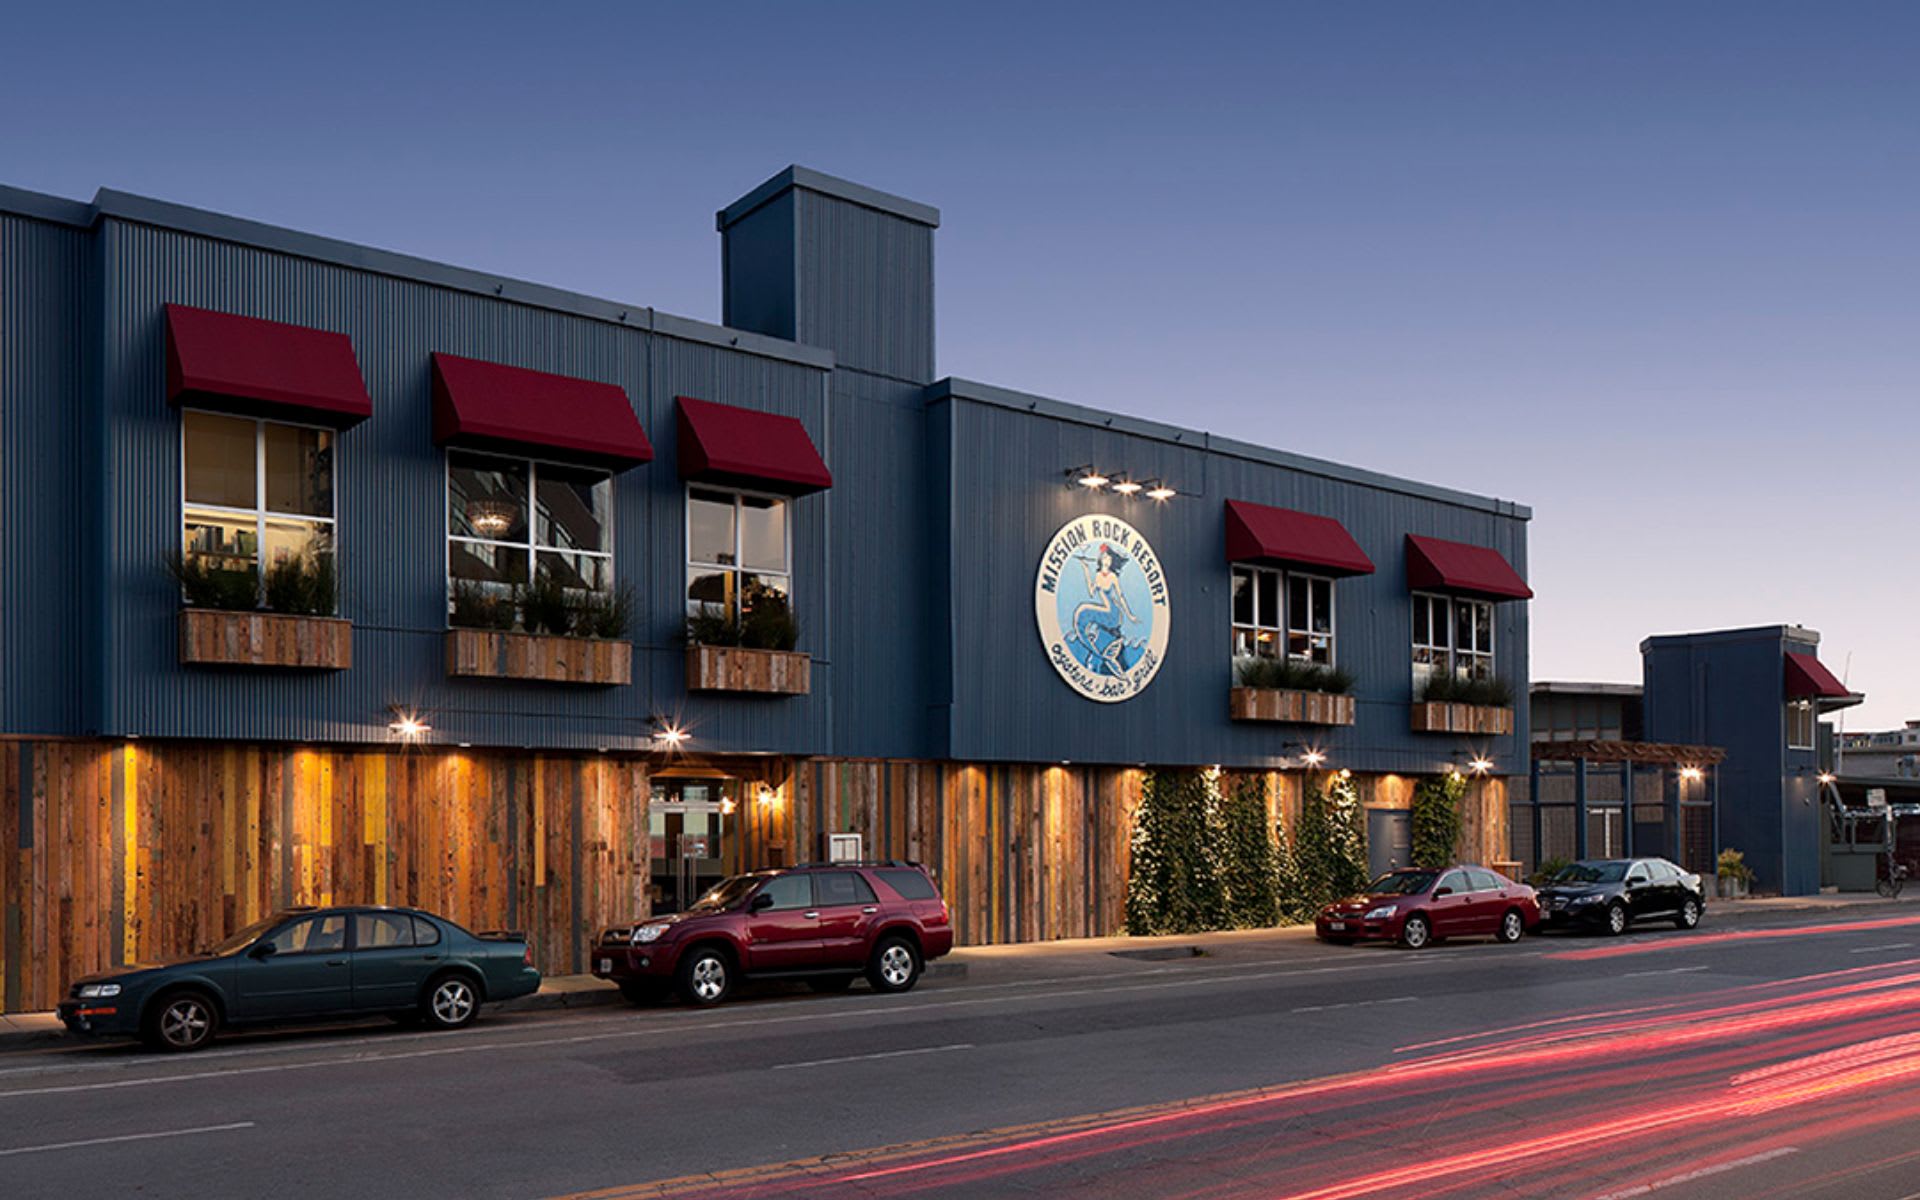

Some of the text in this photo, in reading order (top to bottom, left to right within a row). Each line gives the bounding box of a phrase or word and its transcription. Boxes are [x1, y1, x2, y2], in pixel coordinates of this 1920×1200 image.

[1041, 520, 1166, 607] MISSION ROCK RESORT
